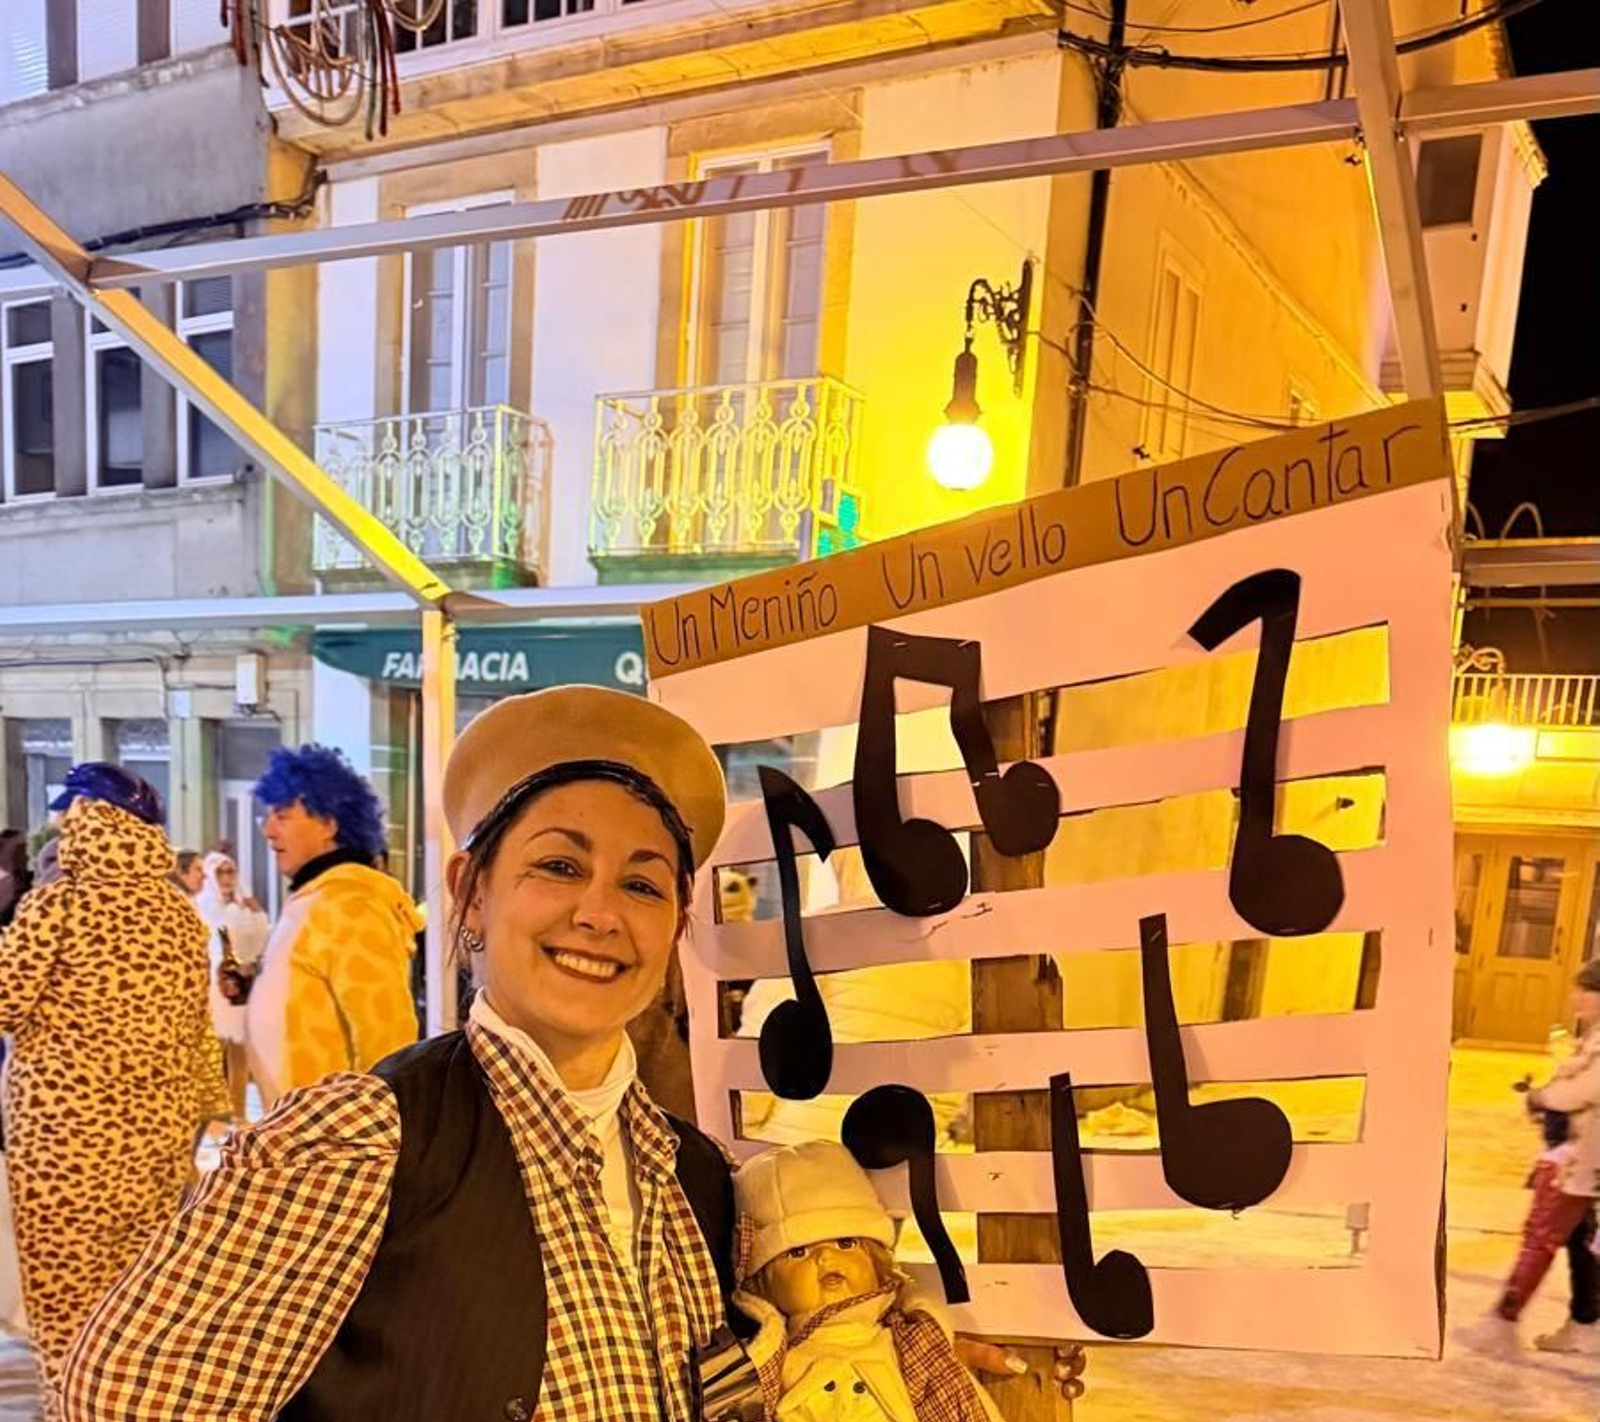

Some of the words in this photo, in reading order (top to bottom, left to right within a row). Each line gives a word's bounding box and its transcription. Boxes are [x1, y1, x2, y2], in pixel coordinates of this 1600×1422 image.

[651, 597, 701, 666] Un
[709, 571, 838, 651] Meniño
[880, 543, 945, 610] Un
[381, 651, 529, 682] FAACIA
